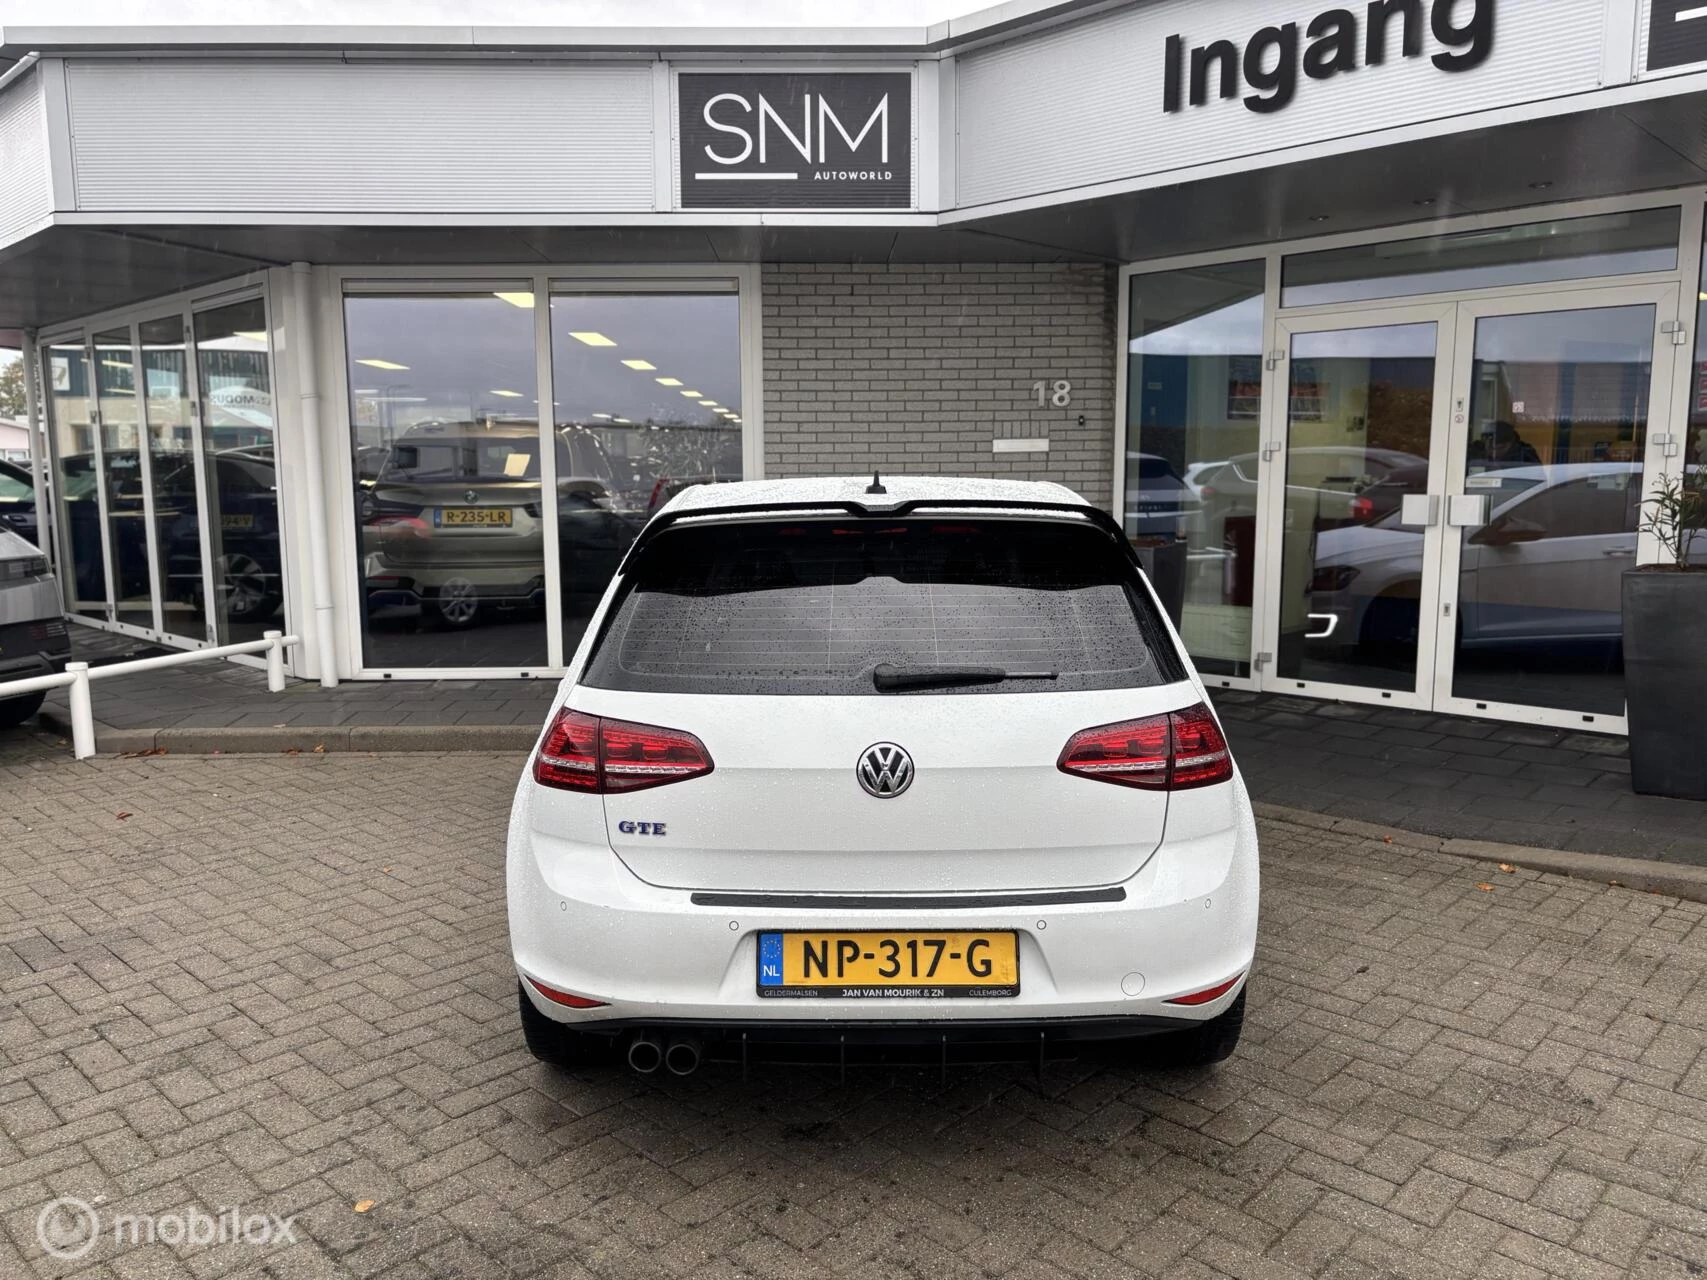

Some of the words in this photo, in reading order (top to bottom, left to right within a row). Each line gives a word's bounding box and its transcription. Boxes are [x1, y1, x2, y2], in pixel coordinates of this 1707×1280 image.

[1163, 0, 1493, 114] Ingang
[703, 92, 888, 165] SNM
[814, 171, 892, 180] AUTOWORLD
[1033, 380, 1071, 407] 18
[446, 511, 506, 523] R-235-LR
[618, 820, 667, 836] GTE
[803, 939, 992, 978] NP-317-G
[763, 965, 780, 977] NL
[764, 989, 818, 997] GELDERMALSEN
[842, 989, 861, 997] JAN
[863, 989, 882, 997] VAN
[884, 989, 921, 997] MOURIK
[923, 989, 930, 997] &
[931, 989, 945, 997] ZN
[969, 989, 1012, 997] CULEMBORG
